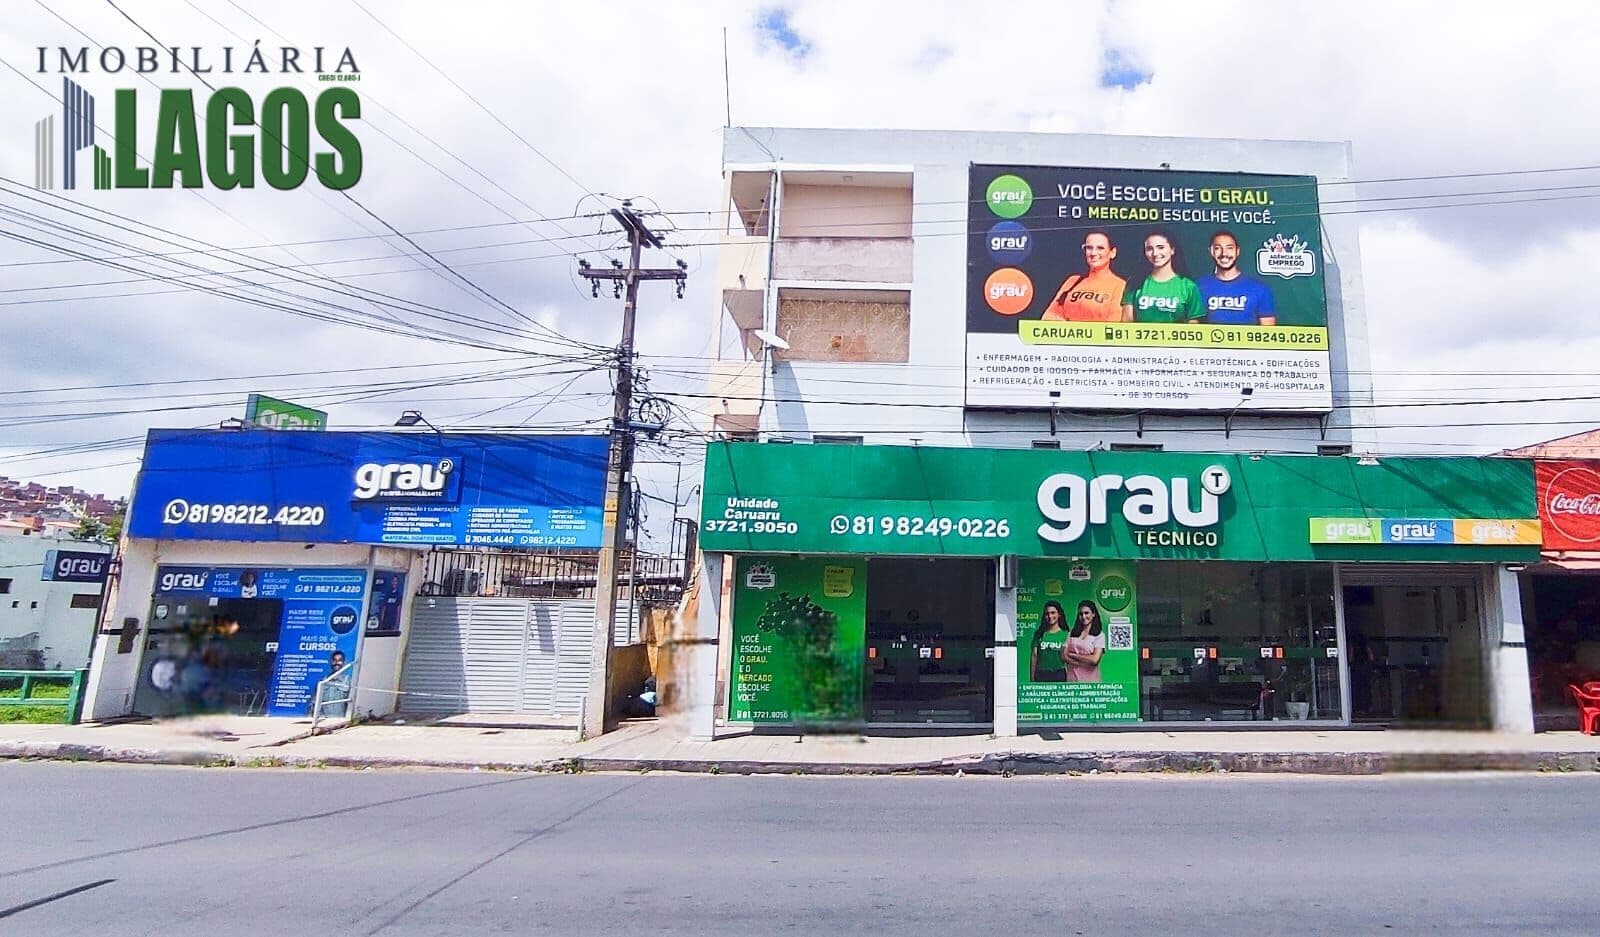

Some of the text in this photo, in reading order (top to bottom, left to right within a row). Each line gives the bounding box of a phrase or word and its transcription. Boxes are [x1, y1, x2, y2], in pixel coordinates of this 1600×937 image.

[1058, 182, 1274, 205] VOCÊ ESCOLHE O GRAU.
[1058, 206, 1276, 225] E O MERCADO ESCOLHE VOCÊ.
[991, 236, 1027, 250] grau
[1139, 295, 1179, 309] grau
[1208, 296, 1246, 310] grau
[1033, 327, 1321, 343] CARUARU 81 3721.9050 81 98249.0226
[983, 354, 1041, 362] ENFERMAGEM
[1051, 355, 1102, 363] RADIOLOGIA
[1190, 357, 1257, 366] ELETROTÉCNICA
[1033, 366, 1044, 374] DE
[1261, 370, 1272, 379] DO
[1273, 371, 1318, 379] TRABALHO
[979, 376, 1325, 390] REFRIGERAÇÃO ELETRICISTA BOMBEIRO CIVIL ATENDIMENTO PRÉ-HOSPITALAR
[1155, 392, 1189, 400] CURSOS
[353, 463, 444, 499] grau
[727, 497, 778, 509] Unidade
[1036, 473, 1219, 544] grau
[724, 508, 780, 521] Caruaru
[705, 520, 798, 534] 3721.9050
[852, 517, 874, 535] 81
[1390, 522, 1436, 541] grau
[1134, 527, 1218, 547] TÉCNICO
[58, 558, 101, 577] grau
[160, 572, 205, 591] grau
[1101, 588, 1125, 599] grau
[740, 634, 760, 643] VOCÊ
[1040, 640, 1061, 650] grau
[299, 642, 337, 651] CURSOS
[740, 645, 772, 653] ESCOLHE
[739, 665, 750, 673] E O
[738, 674, 773, 682] MERCADO
[738, 683, 770, 691] ESCOLHE
